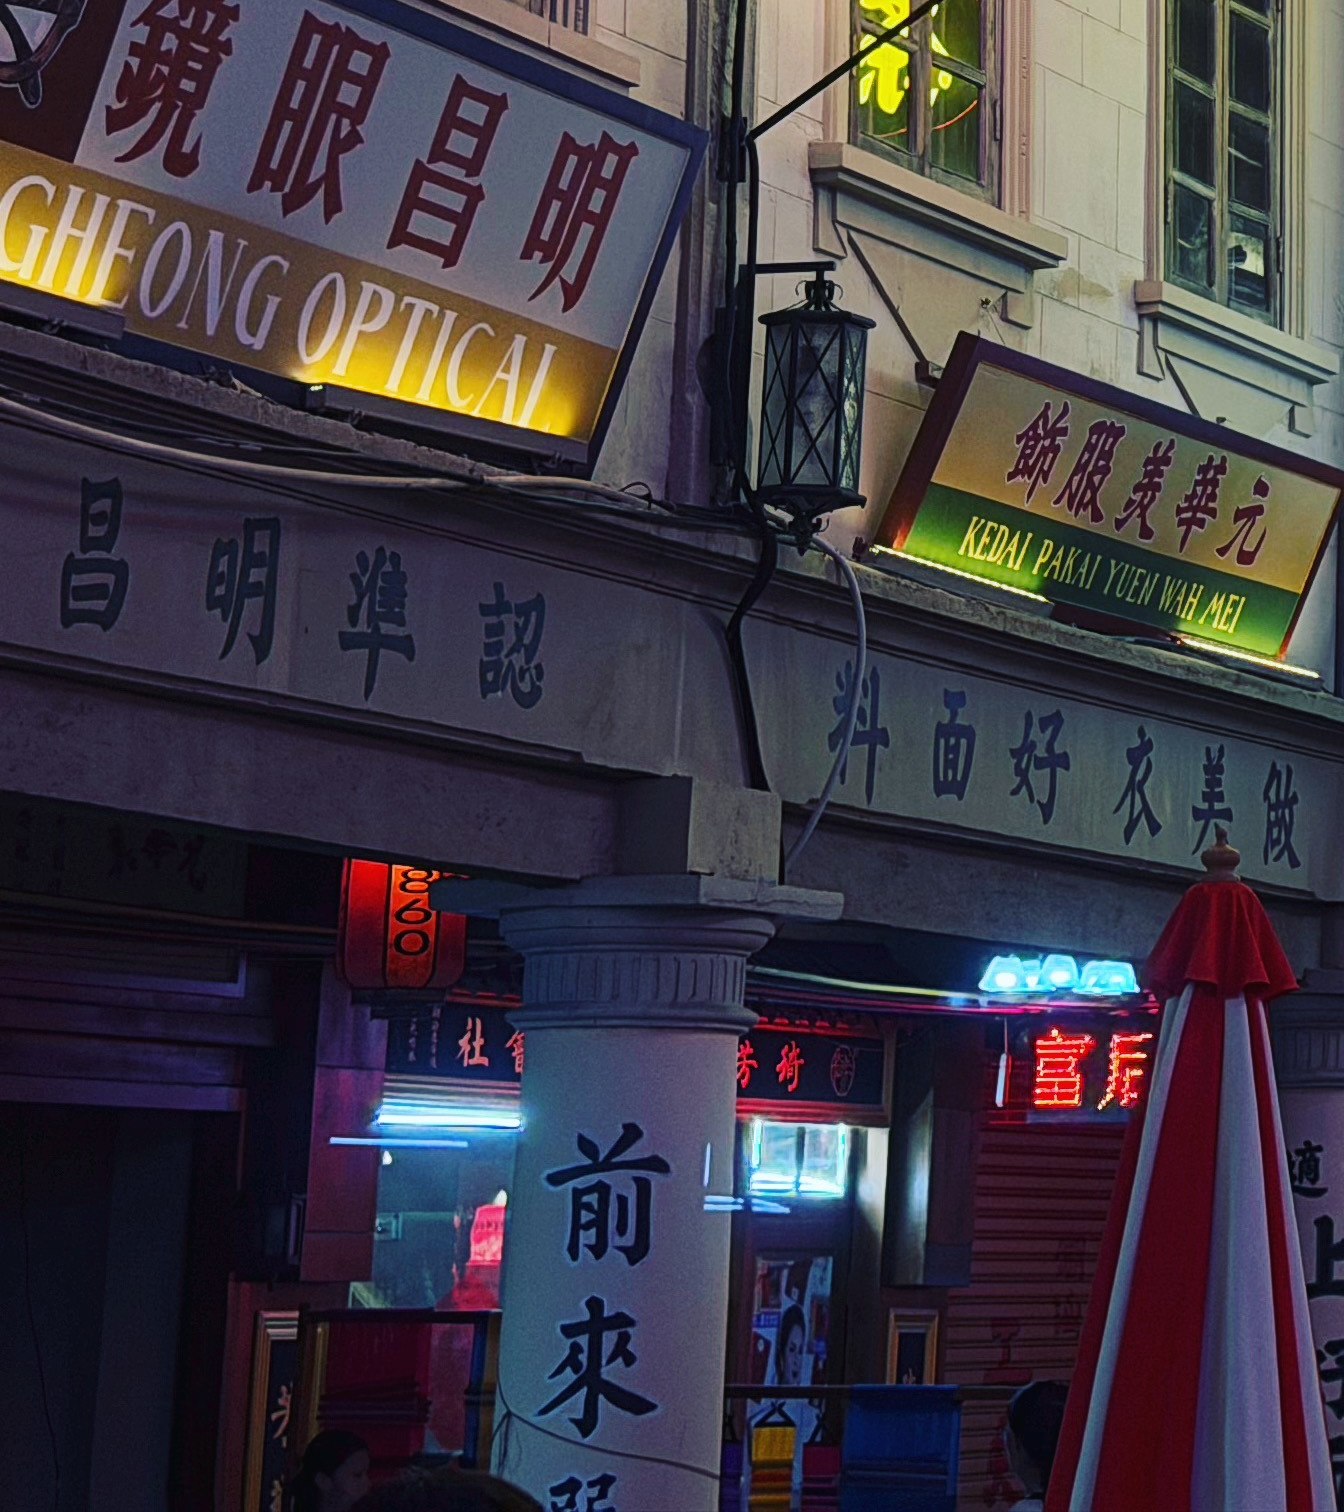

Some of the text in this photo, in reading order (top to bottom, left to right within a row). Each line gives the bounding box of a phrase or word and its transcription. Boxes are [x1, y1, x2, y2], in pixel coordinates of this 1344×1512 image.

[296, 271, 558, 433] OPTICAL
[958, 516, 1247, 634] KEDAI PAKAI YUEN WAH MEI
